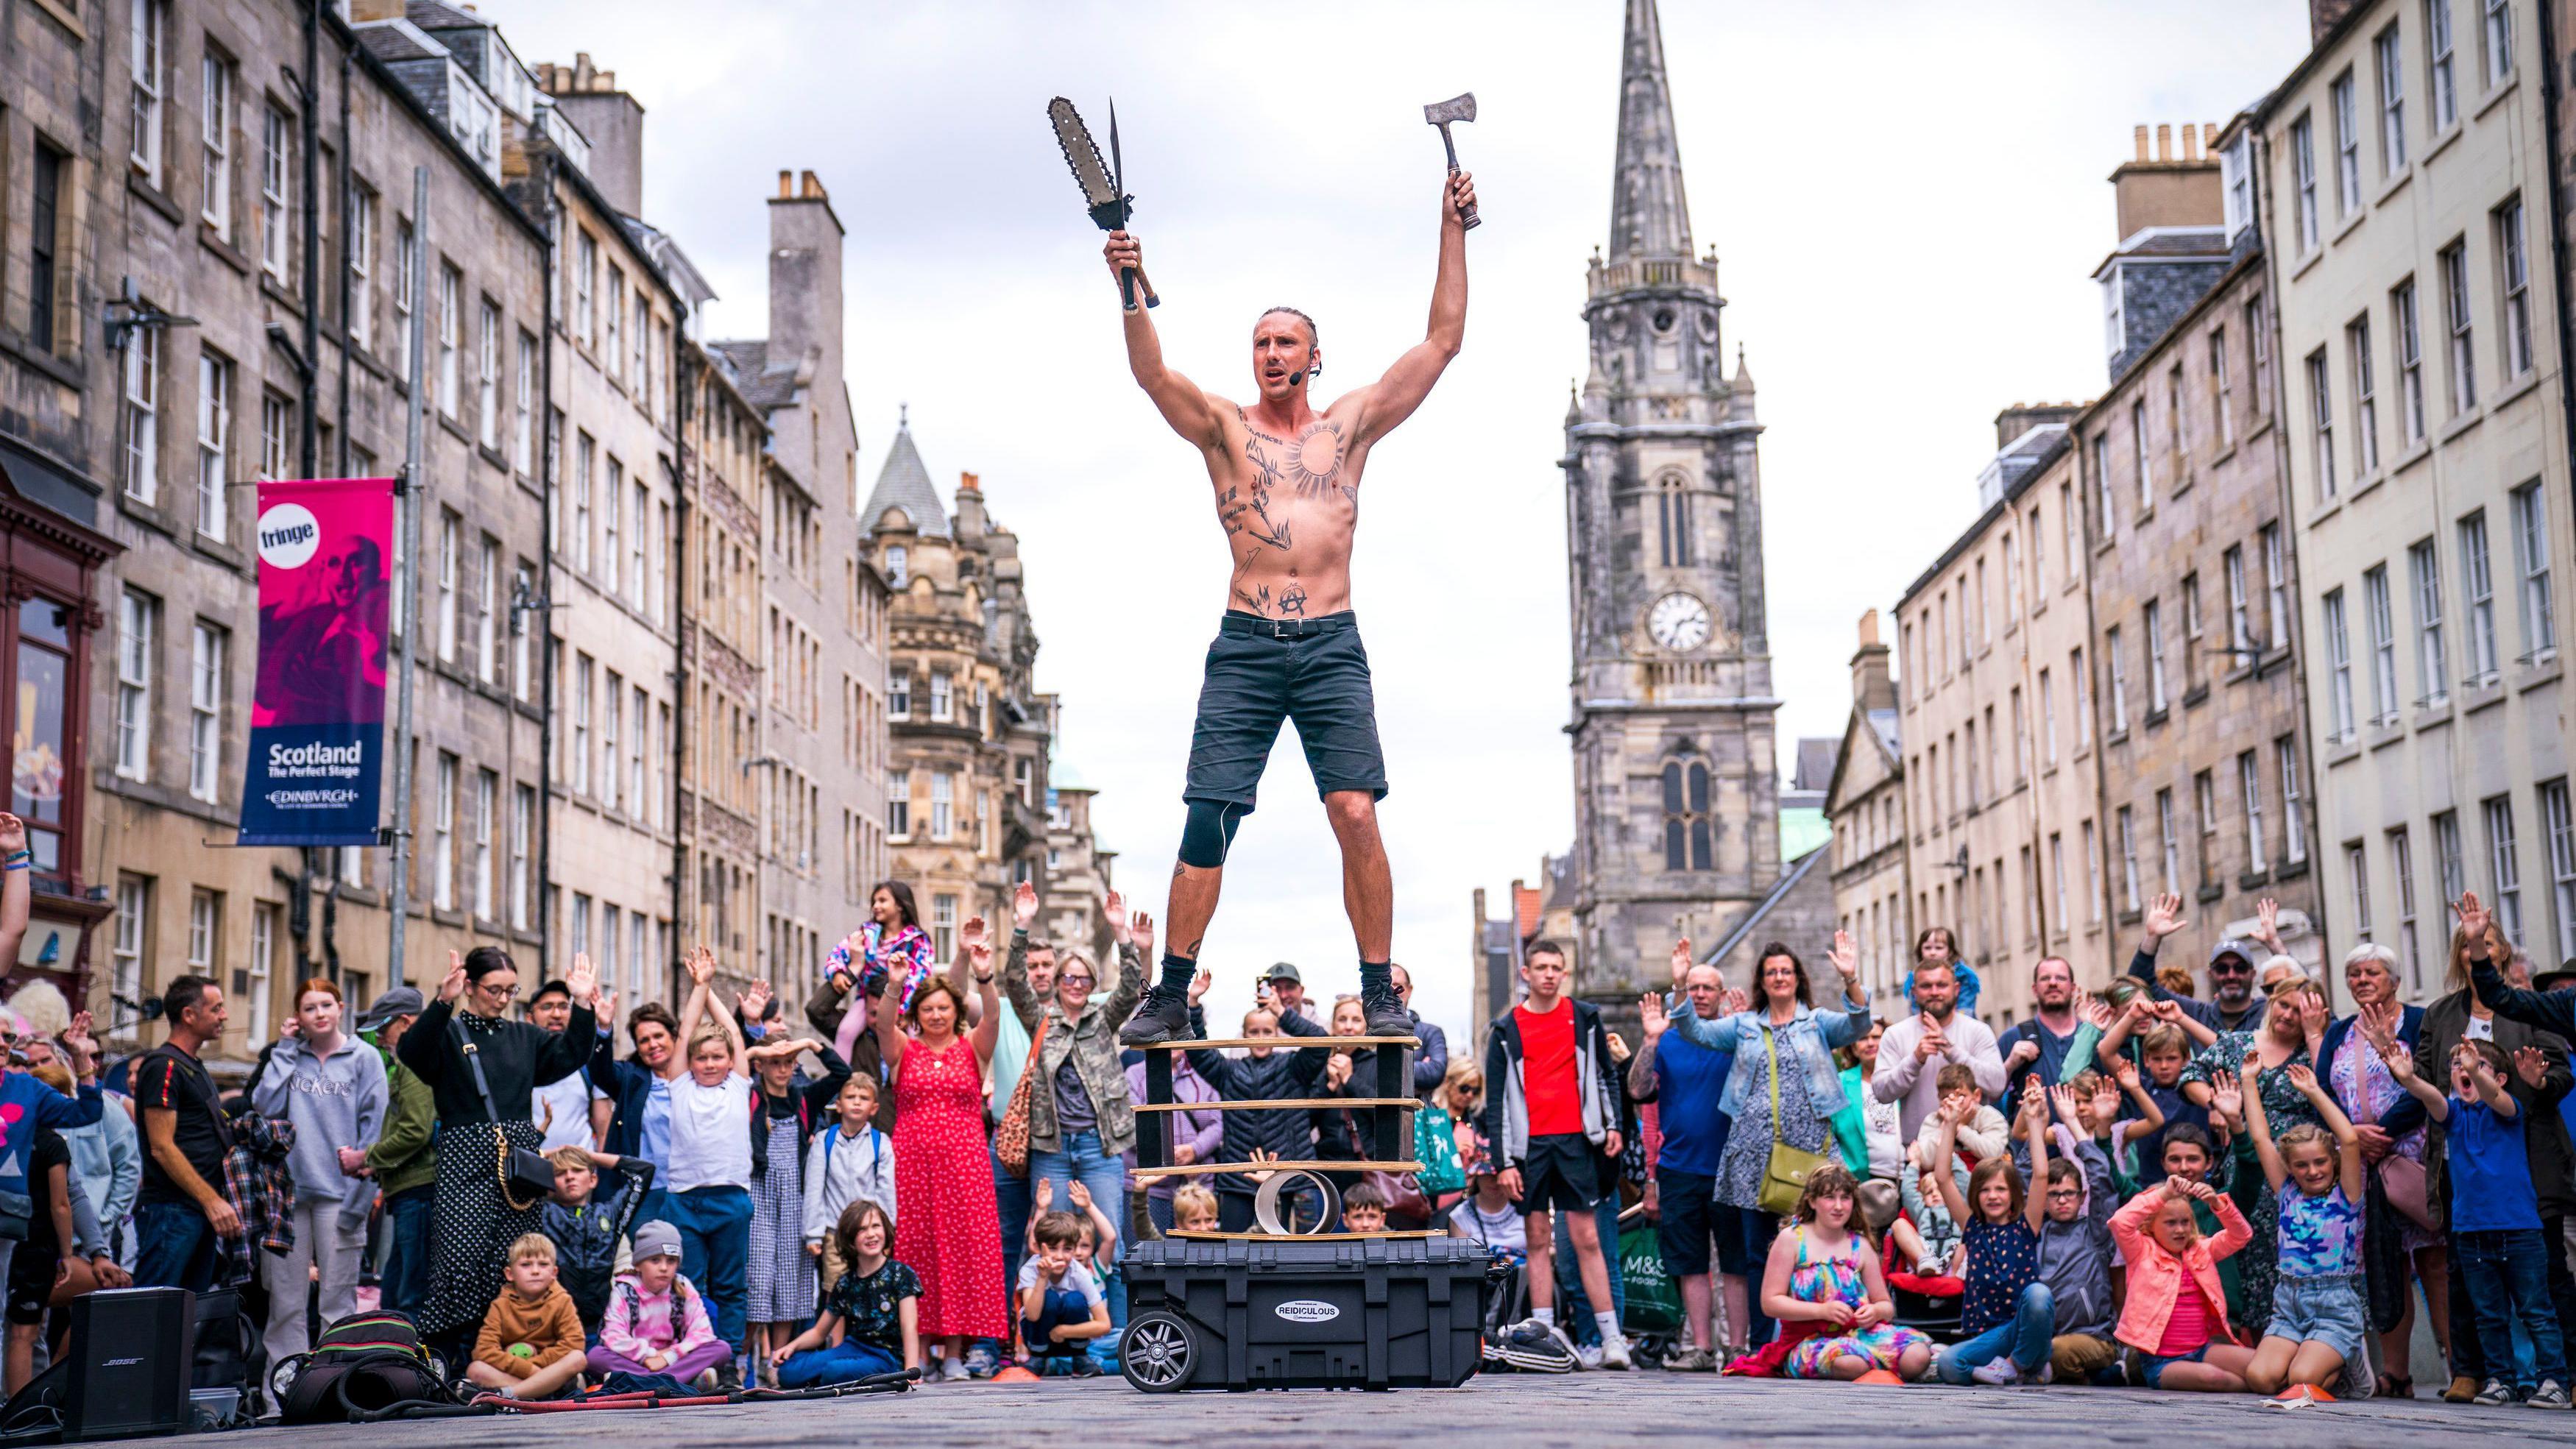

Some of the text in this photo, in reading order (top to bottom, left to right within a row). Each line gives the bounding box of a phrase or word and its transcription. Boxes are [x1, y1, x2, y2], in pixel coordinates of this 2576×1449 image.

[261, 523, 314, 548] fringe
[269, 740, 362, 766] Scotland
[269, 765, 360, 779] The Perfect Stage
[1624, 1255, 1668, 1278] M&S
[1278, 1307, 1336, 1315] REIDICULOUS
